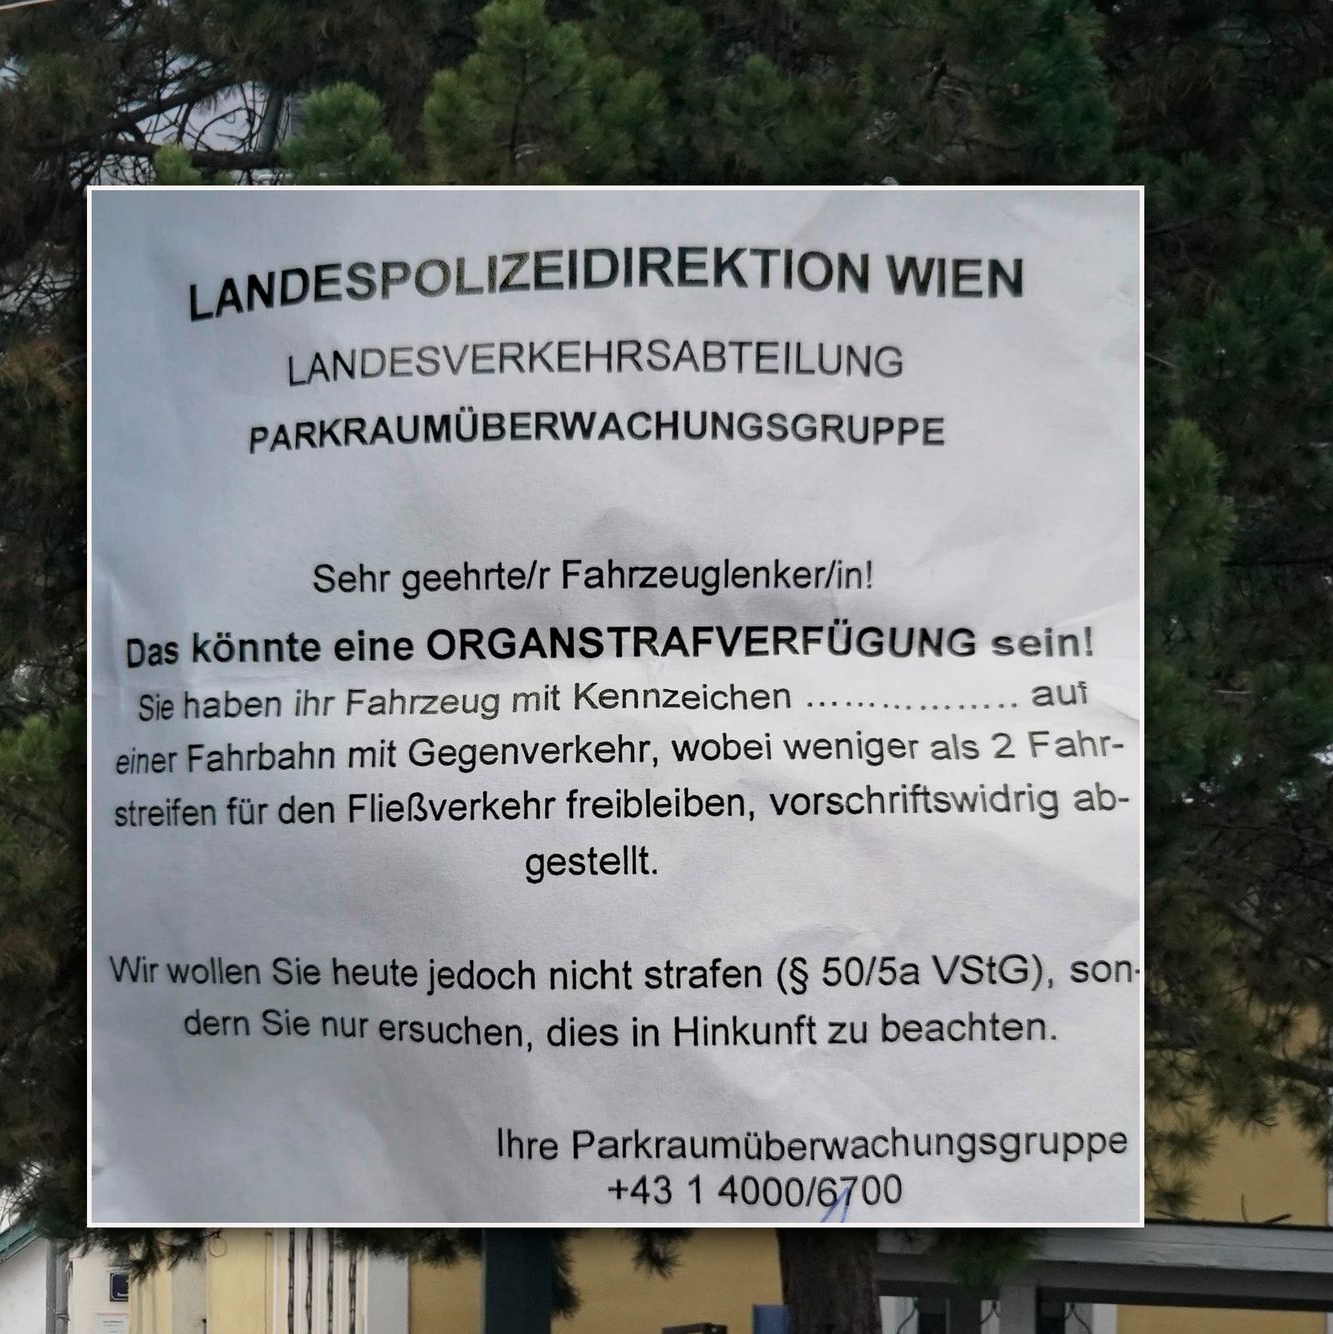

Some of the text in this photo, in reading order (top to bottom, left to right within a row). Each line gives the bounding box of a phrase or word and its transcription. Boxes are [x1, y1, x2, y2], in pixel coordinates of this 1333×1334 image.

[187, 244, 1025, 324] LANDESPOLIZEIDIREKTION WIEN
[286, 337, 905, 388] LANDESVERKEHRSABTEILUNG
[247, 404, 947, 456] PARKRAUMÜBERWACHUNGSGRUPPE
[311, 556, 874, 601] Sehr geehrte/r Fahrzeuglenker/in!
[125, 615, 1095, 671] Das könnte eine ORGANSTRAFVERFÜGUNG sein!
[137, 692, 176, 724] Sie
[182, 689, 283, 720] haben
[293, 688, 337, 718] ihr
[345, 687, 501, 722] Fahrzeug
[511, 683, 562, 714] mit
[573, 681, 793, 712] Kennzeichen
[1030, 679, 1089, 709] auf
[114, 728, 1126, 777] einer Fahrbahn mit Gegenverkehr, wobei weniger als 2 Fahr-
[113, 780, 1131, 829] streifen für den Fließverkehr freibleiben, vorschriftswidrig ab-
[524, 843, 659, 886] gestellt.
[107, 954, 160, 984] Wir
[165, 955, 262, 987] wollen
[270, 955, 322, 987] Sie
[330, 955, 420, 989] heute
[425, 957, 537, 998] jedoch
[548, 957, 634, 992] nicht
[643, 955, 764, 991] strafen
[775, 954, 811, 997] (§
[821, 954, 922, 989] 50/5a
[930, 952, 1055, 993] VStG),
[182, 1007, 1058, 1054] dern Sie nur ersuchen, dies in Hinkunft zu beachten.
[496, 1125, 1130, 1166] Ihre Parkraumüberwachungsgruppe
[606, 1172, 904, 1212] +43 1 4000/6700
